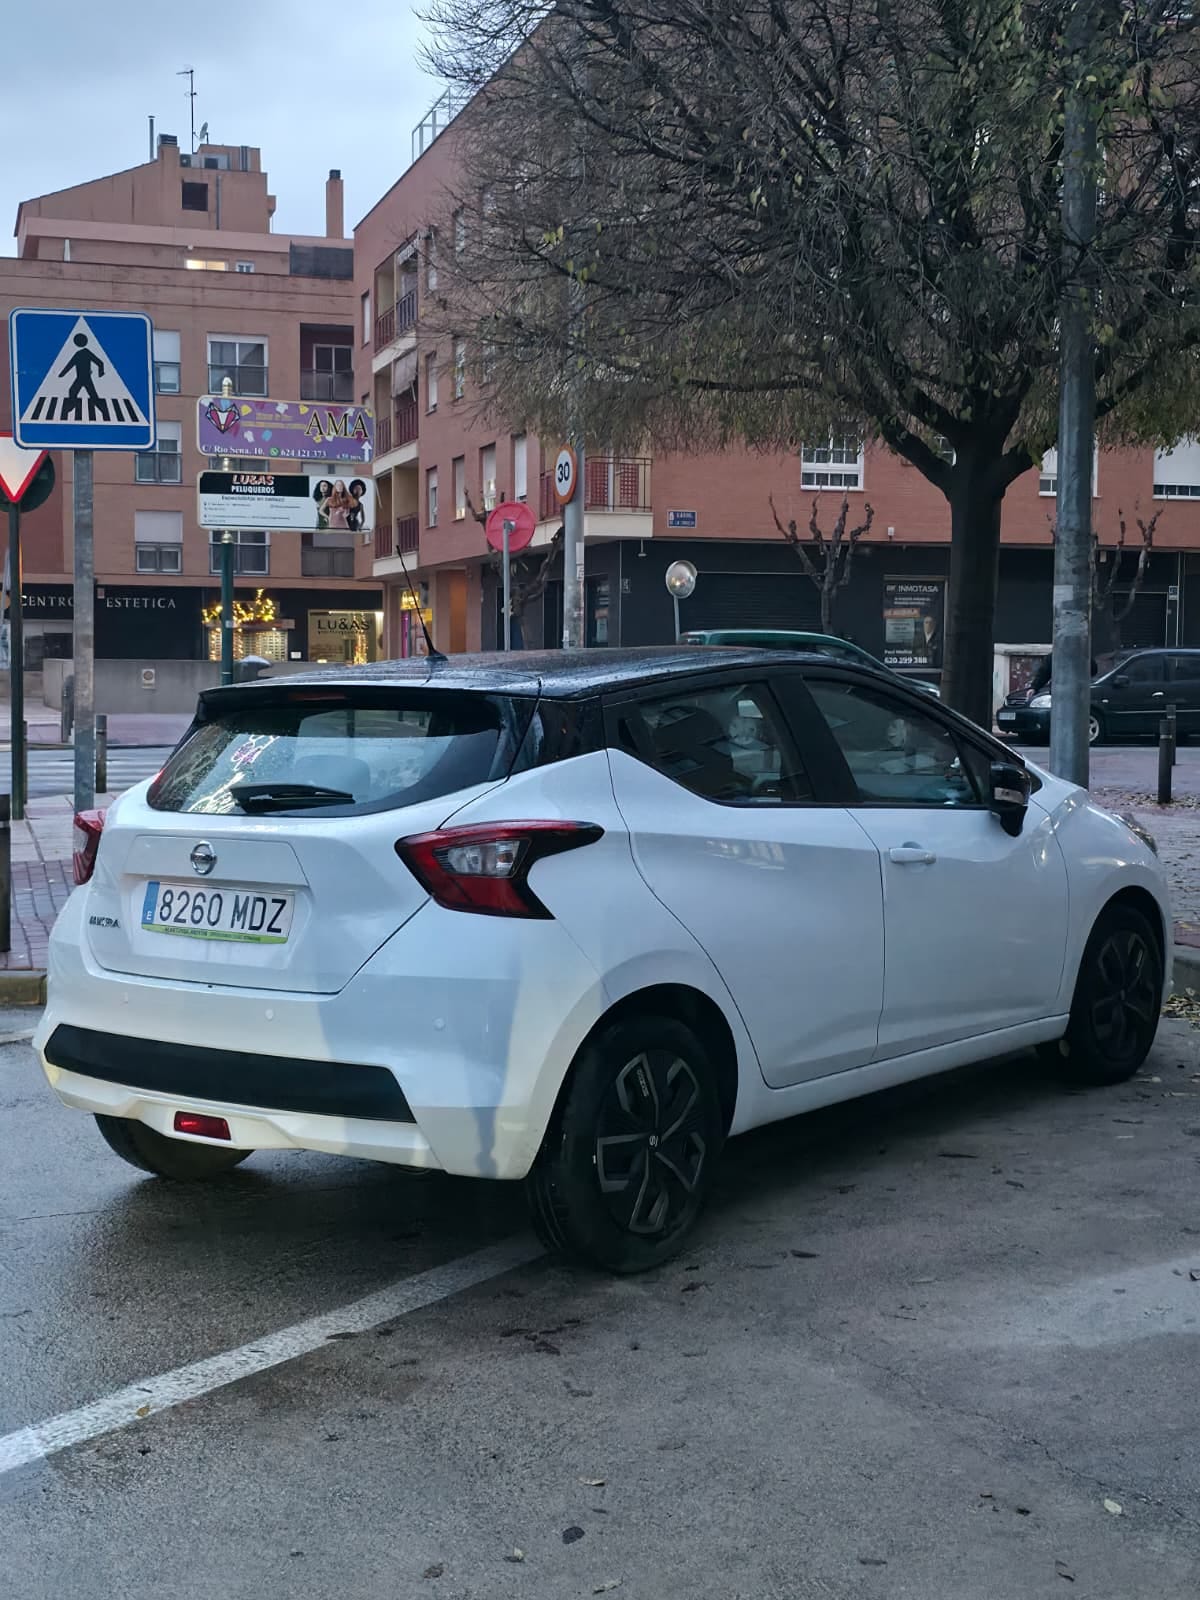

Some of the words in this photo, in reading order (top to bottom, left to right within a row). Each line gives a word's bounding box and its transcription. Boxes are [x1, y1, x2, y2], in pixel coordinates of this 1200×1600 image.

[304, 410, 369, 438] AMA
[557, 461, 570, 483] 30
[231, 485, 275, 494] PELUQUEROS
[898, 585, 939, 593] INMOTASA
[106, 597, 176, 609] ESTETICA
[146, 911, 152, 921] E
[159, 889, 224, 927] 8260
[230, 894, 287, 934] MDZ
